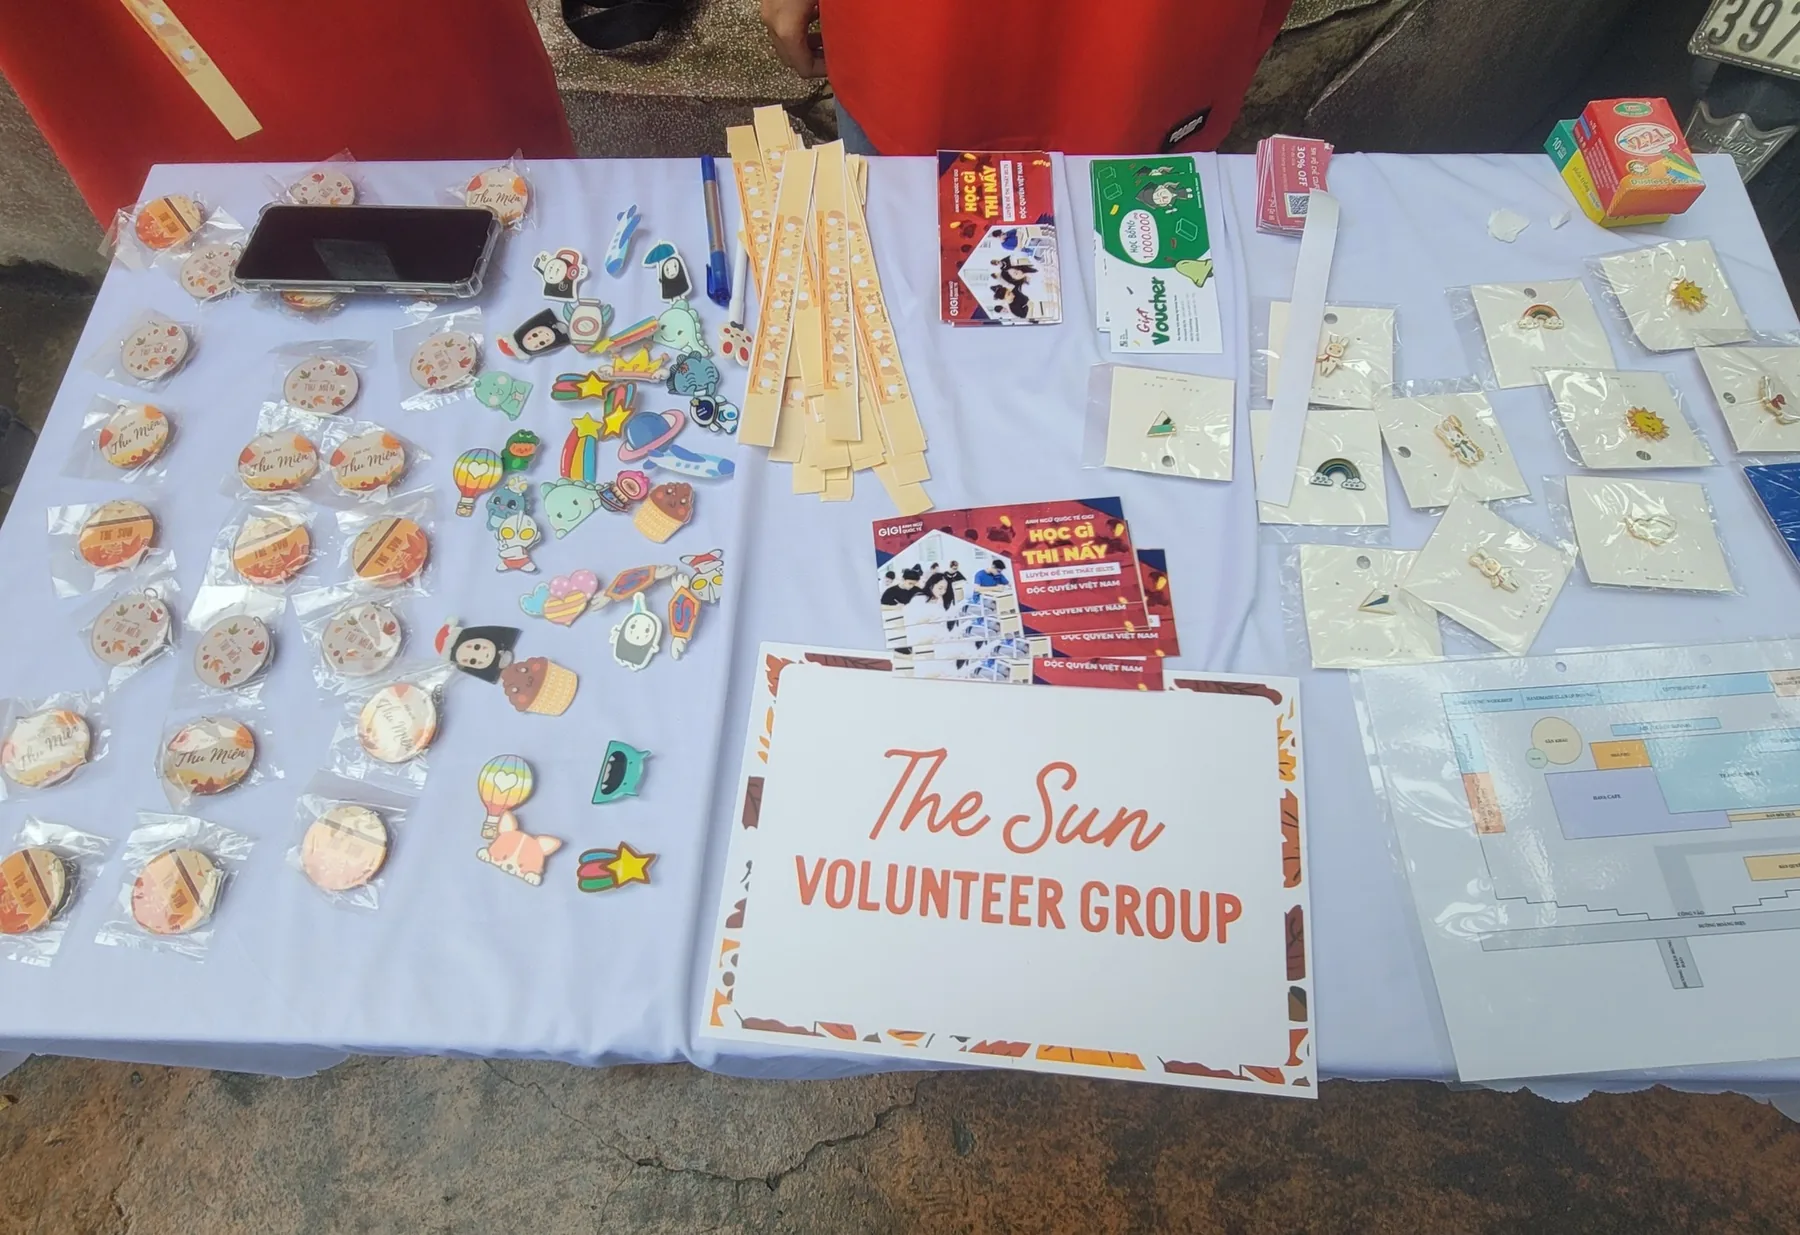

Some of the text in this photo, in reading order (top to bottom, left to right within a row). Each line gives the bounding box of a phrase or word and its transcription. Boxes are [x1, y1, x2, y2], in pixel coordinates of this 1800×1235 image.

[1296, 145, 1308, 187] 30% OFF
[961, 171, 980, 212] HỌC GÌ
[979, 165, 999, 219] THI NẤY
[1139, 213, 1154, 259] 1.000.000
[1136, 307, 1154, 333] Gift
[1148, 276, 1170, 346] Voucher
[878, 525, 902, 537] GIGI
[1029, 521, 1095, 545] HỌC GÌ
[1022, 541, 1108, 565] THI NẤY
[1026, 579, 1121, 595] ĐỘC QUYỀN VIỆT NAM
[1043, 660, 1143, 673] ĐỘC QUYỀN VIỆT NAM
[175, 745, 205, 768] Thu
[868, 747, 1166, 854] The Sun
[794, 854, 1242, 944] VOLUNTEER GROUP
